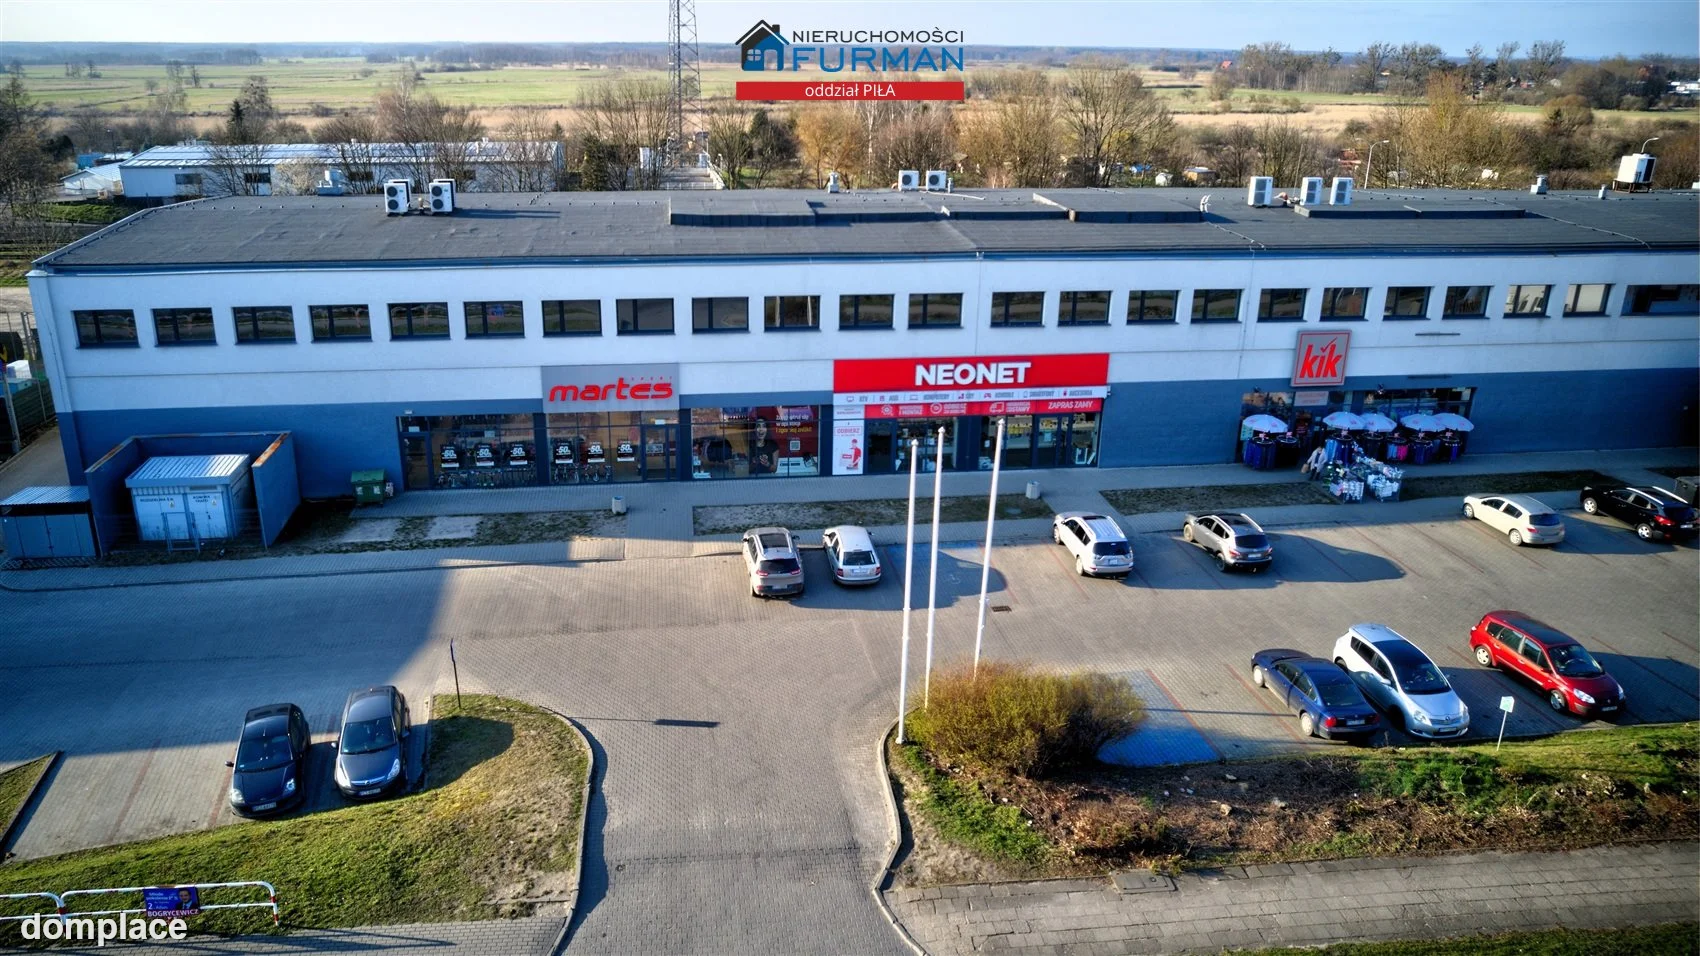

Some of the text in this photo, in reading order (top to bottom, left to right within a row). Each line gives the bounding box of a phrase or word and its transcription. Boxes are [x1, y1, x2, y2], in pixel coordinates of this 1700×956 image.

[915, 362, 1031, 386] NEONET
[548, 377, 673, 402] martes
[147, 909, 199, 917] BOGRYCEWICZ
